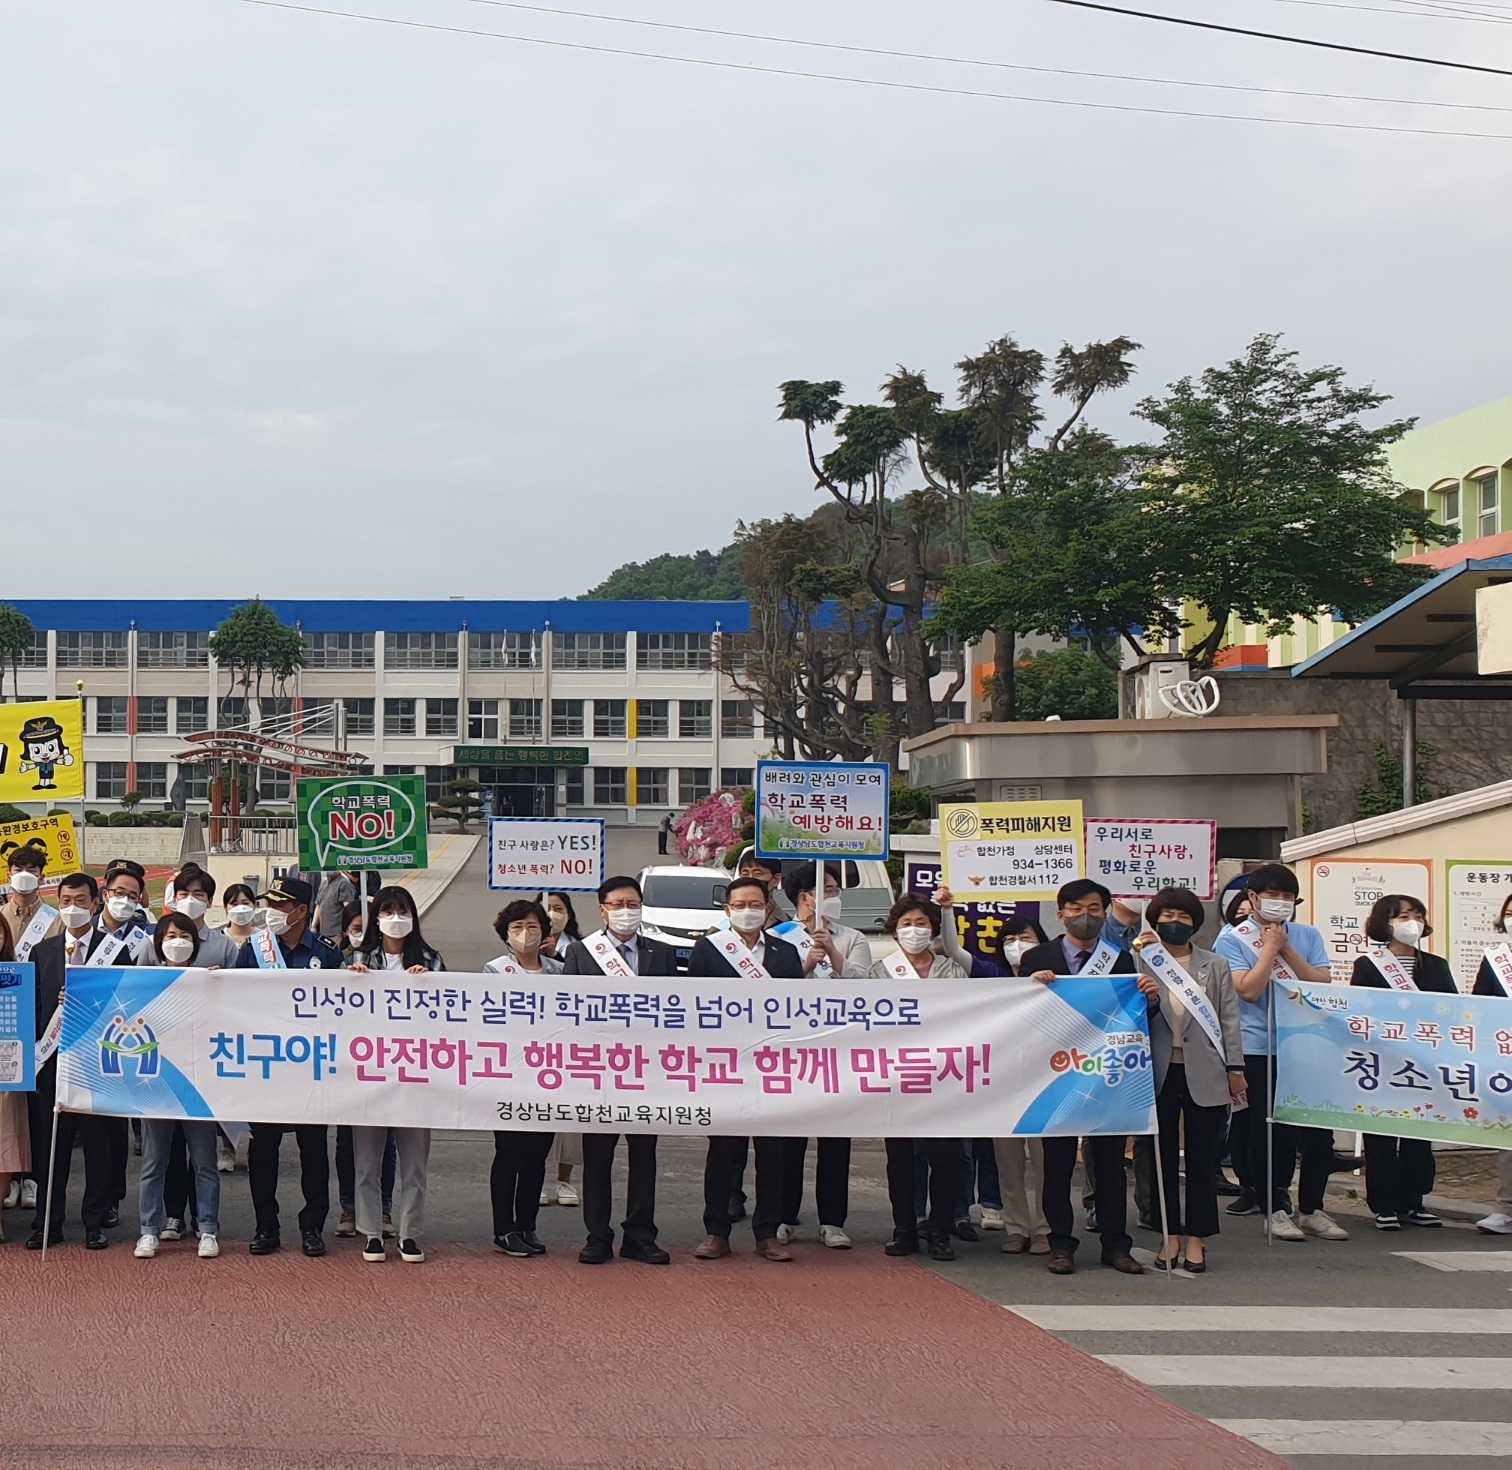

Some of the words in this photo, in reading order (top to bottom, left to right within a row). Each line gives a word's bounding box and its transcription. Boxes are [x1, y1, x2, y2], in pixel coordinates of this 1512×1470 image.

[765, 772, 805, 785] 배려와
[809, 773, 850, 787] 관심이
[855, 774, 881, 786] 모여
[331, 794, 392, 810] 학교폭력
[767, 792, 848, 812] 학교폭력
[330, 810, 395, 841] NO!
[792, 815, 882, 833] 예방해요!
[979, 816, 1073, 834] 폭력피해지원
[1094, 826, 1153, 842] 우리서로
[497, 839, 517, 851] 친구
[519, 839, 555, 851] 사랑은?
[557, 835, 597, 850] YES!
[976, 845, 1016, 858] 합천가정
[1033, 844, 1074, 857] 상담센터
[1128, 844, 1194, 861] 친구사랑,
[497, 863, 527, 875] 청소년
[529, 863, 555, 876] 폭력?
[560, 859, 594, 875] NO!
[1011, 858, 1074, 871] 934-1366
[1098, 859, 1157, 875] 평화로운
[988, 874, 1037, 886] 합천경찰서
[1038, 873, 1059, 886] 112
[1131, 876, 1197, 892] 우리학교!
[1466, 872, 1500, 884] 운동장
[1354, 891, 1384, 901] STOP
[1330, 915, 1359, 929] 학교
[291, 986, 376, 1019] 인성이
[383, 987, 472, 1023] 진정한
[479, 988, 546, 1025] 실력!
[555, 990, 687, 1028] 학교폭력을
[695, 994, 754, 1029] 넘어
[764, 996, 922, 1031] 인성교육으로
[1327, 996, 1348, 1010] 합천
[1106, 1033, 1144, 1046] 경남교육
[1346, 1015, 1476, 1052] 학교폭력
[209, 1032, 337, 1082] 친구야!
[348, 1034, 513, 1086] 안전하고
[523, 1038, 650, 1091] 행복한
[658, 1043, 744, 1092] 학교
[753, 1044, 841, 1094] 함께
[851, 1042, 992, 1094] 만들자!
[1049, 1047, 1152, 1086] 아이좋아
[496, 1101, 712, 1126] 경상남도합천교육지원청
